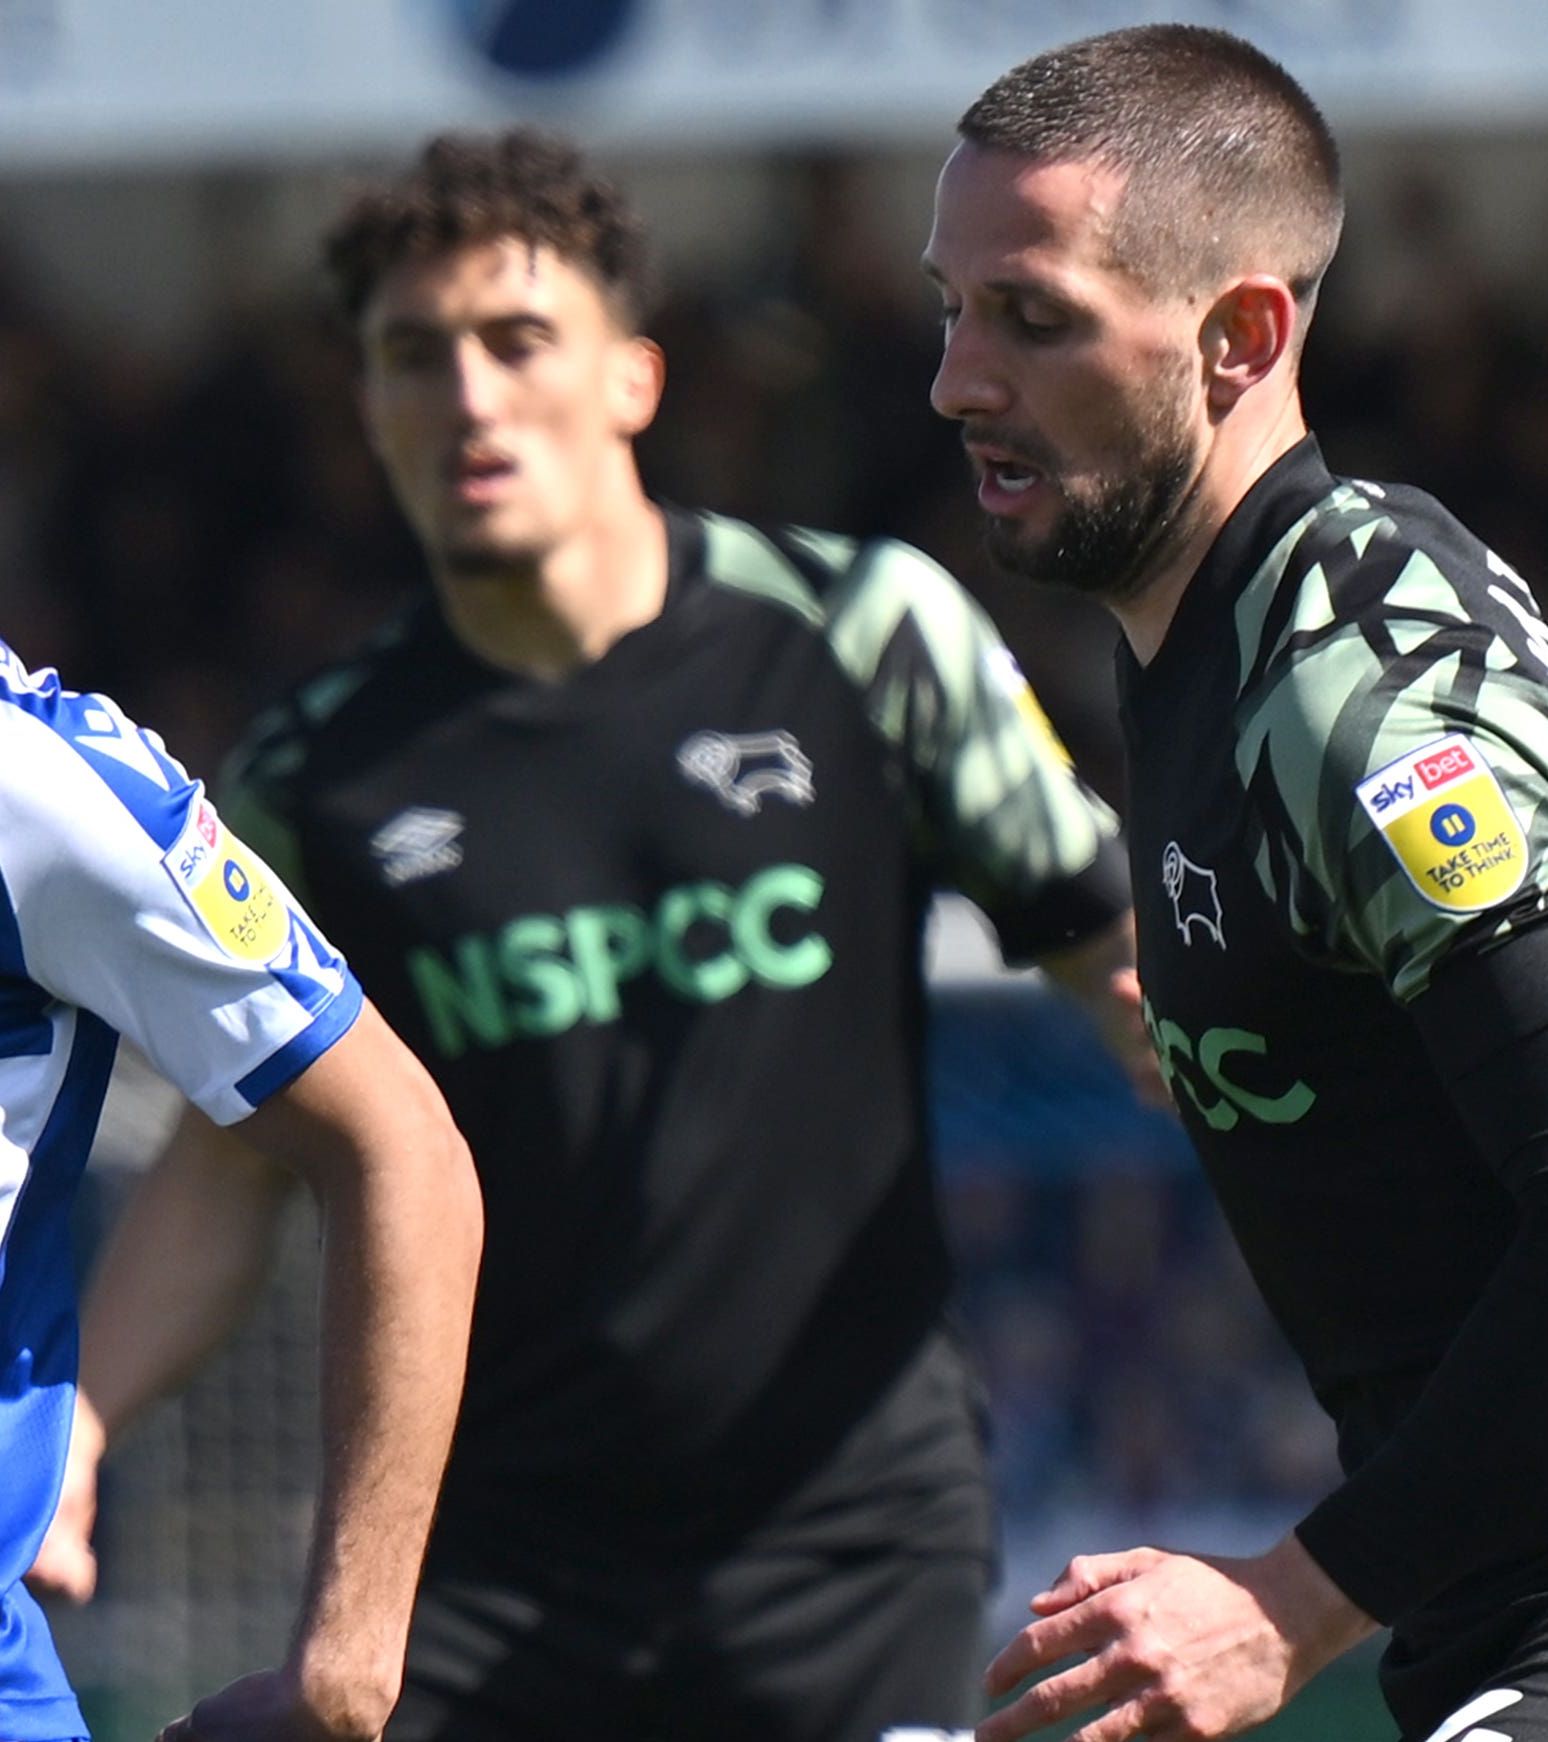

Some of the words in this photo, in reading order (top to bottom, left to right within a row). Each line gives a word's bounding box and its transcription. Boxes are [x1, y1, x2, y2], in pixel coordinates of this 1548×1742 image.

[1370, 775, 1415, 813] sky
[1419, 749, 1470, 784] bet
[1426, 850, 1472, 883] TAKE
[1472, 831, 1511, 859] TIME
[1438, 873, 1466, 893] TO
[1466, 846, 1513, 879] THINK
[408, 861, 833, 1060] NSPCC
[1144, 996, 1317, 1132] CC
